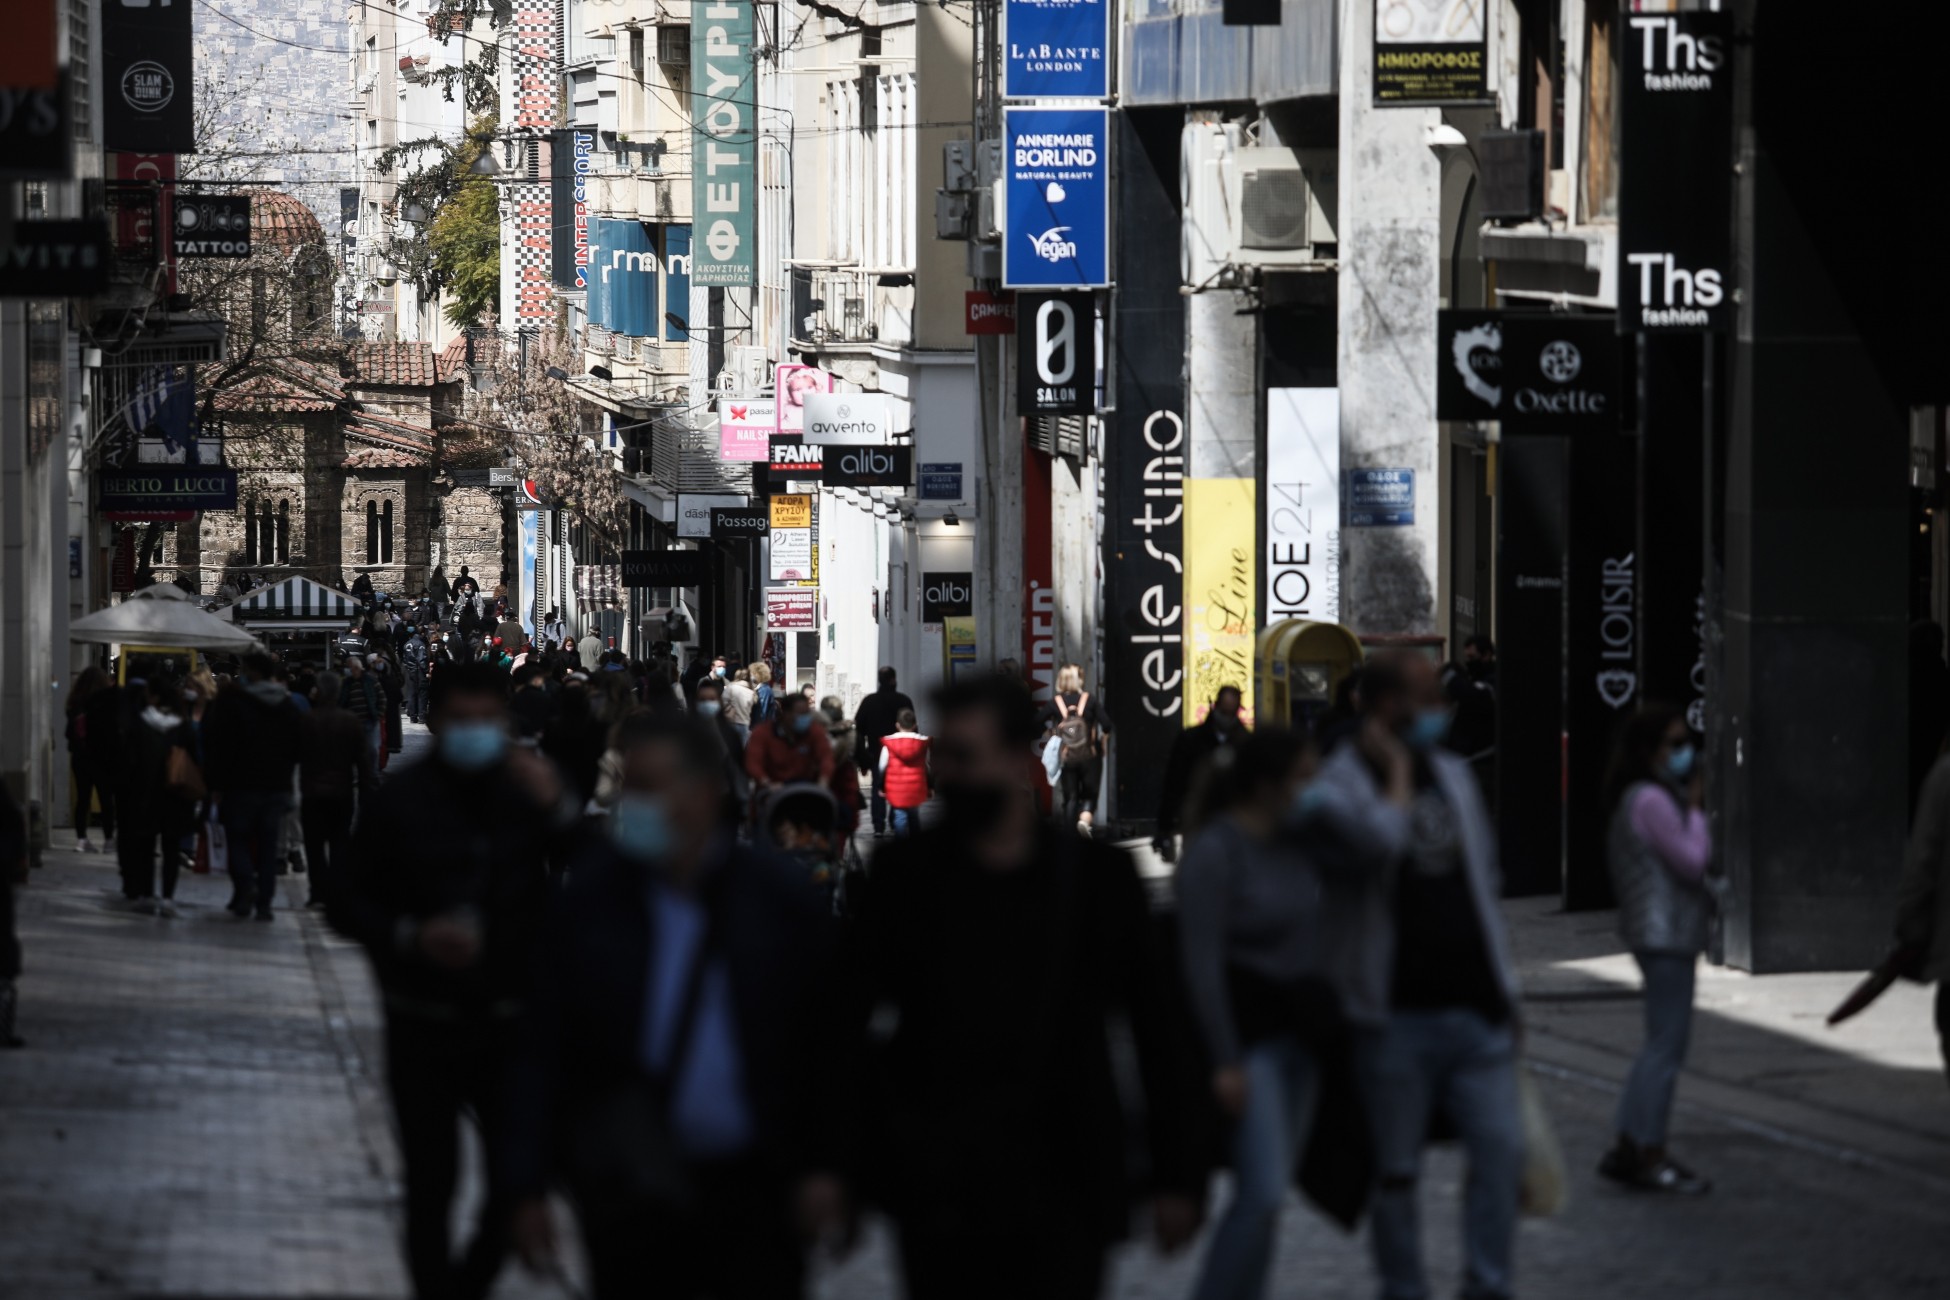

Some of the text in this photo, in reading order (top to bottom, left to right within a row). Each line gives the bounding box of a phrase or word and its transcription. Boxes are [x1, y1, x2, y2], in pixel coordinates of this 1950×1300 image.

[1629, 17, 1724, 71] Ths
[1026, 61, 1083, 72] LONDON
[134, 74, 162, 86] SLAM
[1643, 72, 1711, 91] fashion
[134, 86, 162, 99] DUNK
[1015, 134, 1094, 148] ANNEMARIE
[1015, 172, 1094, 180] NATURAL BEAUTY
[174, 240, 249, 254] TATTOO
[1026, 226, 1077, 263] Vegan
[519, 202, 554, 317] POP-AIR
[696, 264, 750, 274] ΑΚΟΥΣΤΙΚΑ
[1626, 253, 1724, 306] Ths
[1640, 307, 1710, 327] fashion
[1036, 387, 1076, 403] SALON
[749, 408, 775, 416] pasar
[811, 420, 876, 434] avvento
[736, 429, 757, 441] NAIL
[840, 448, 894, 474] alibi
[103, 477, 227, 492] BERTO LUCCI
[777, 496, 804, 505] ΑΓΟΡΑ
[775, 506, 806, 515] ΧΡΥΣΟΥ
[717, 513, 769, 531] Passag
[625, 563, 693, 575] ROMANO
[925, 581, 970, 603] alibi
[1600, 550, 1636, 660] LOISIR
